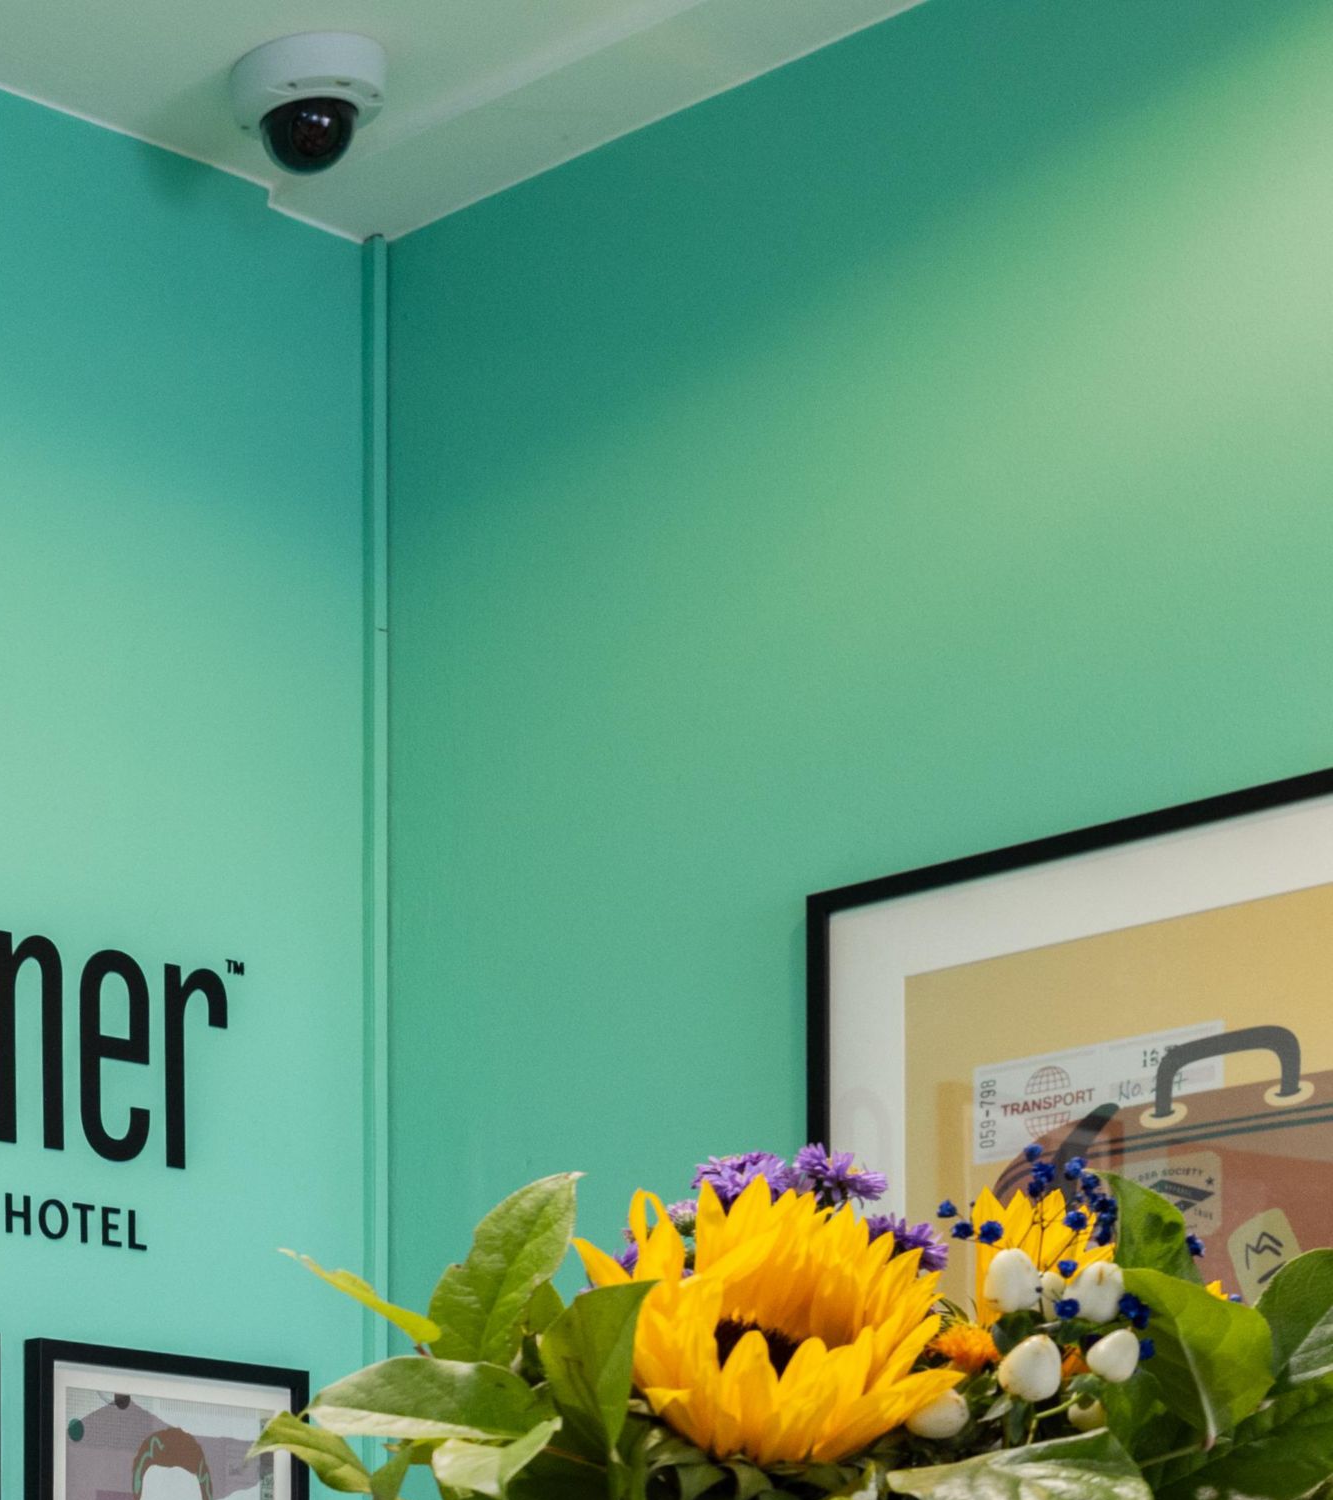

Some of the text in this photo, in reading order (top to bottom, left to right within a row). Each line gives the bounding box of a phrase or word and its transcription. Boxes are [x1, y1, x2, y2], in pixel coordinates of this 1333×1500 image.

[979, 1079, 997, 1149] 059-798
[1000, 1087, 1096, 1118] TRANSPORT
[4, 1192, 148, 1251] HOTEL
